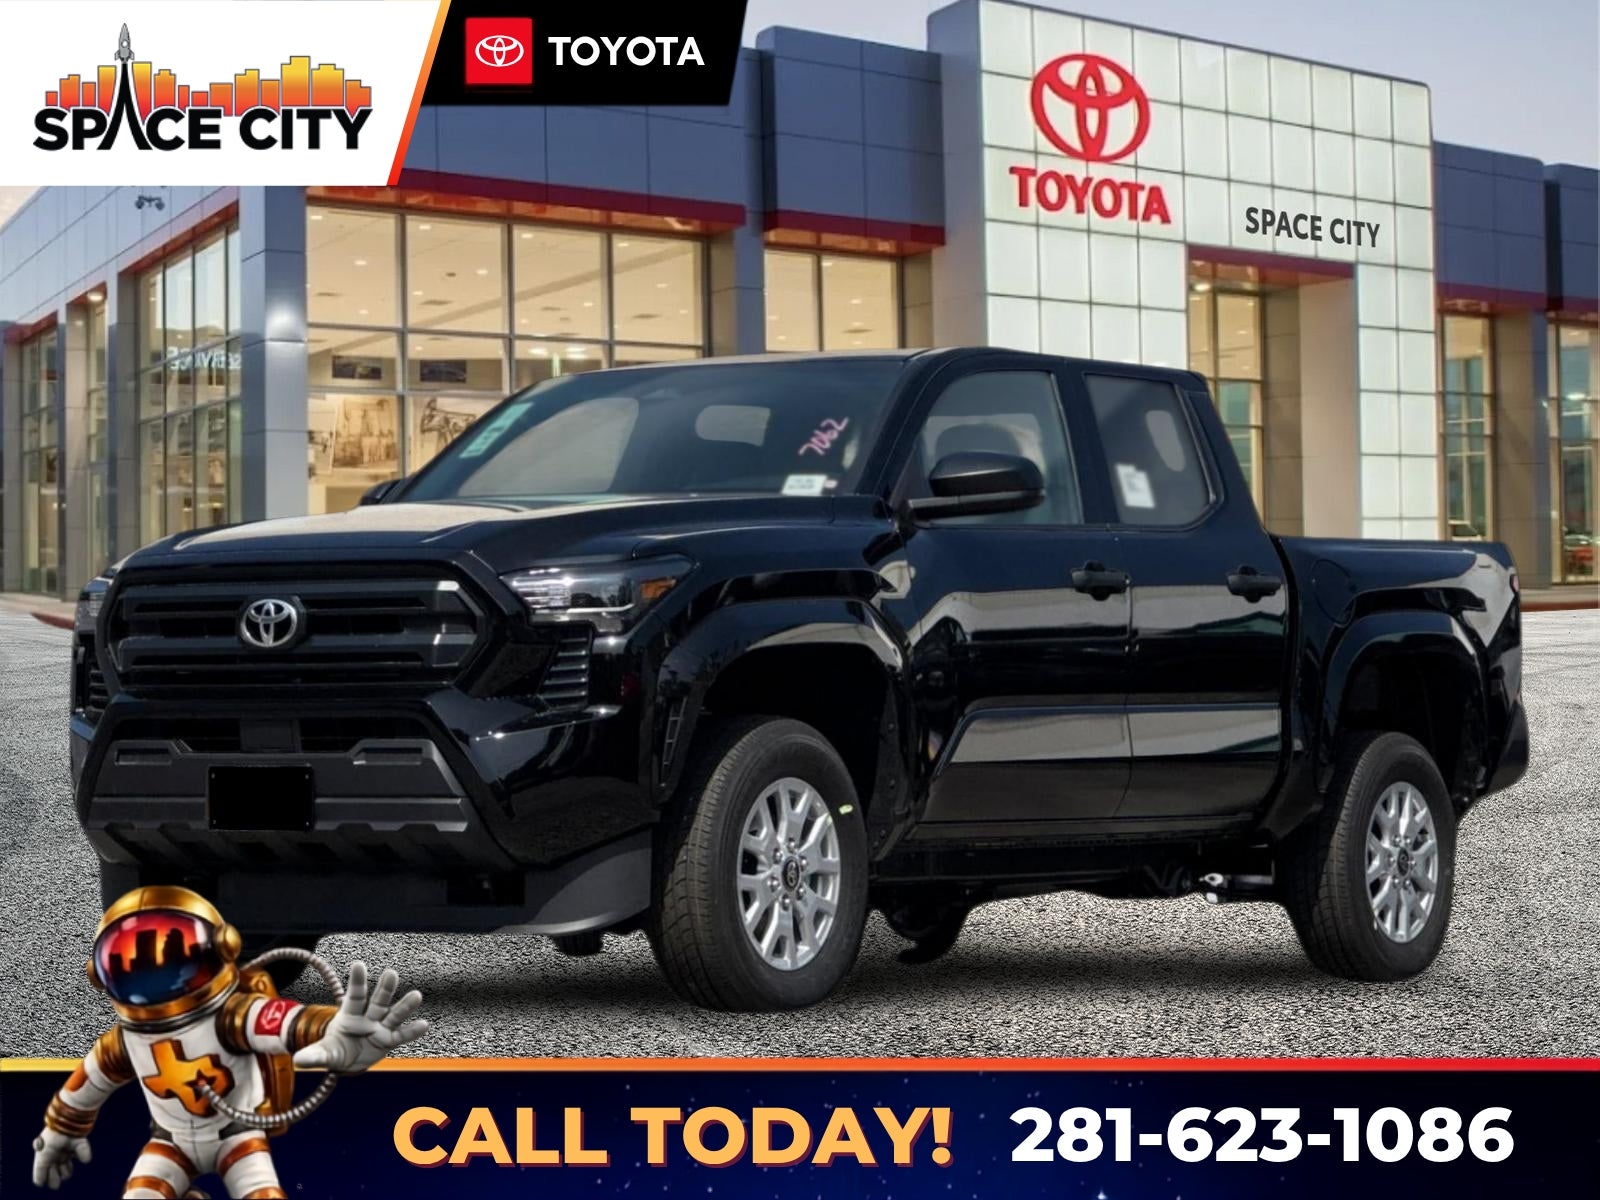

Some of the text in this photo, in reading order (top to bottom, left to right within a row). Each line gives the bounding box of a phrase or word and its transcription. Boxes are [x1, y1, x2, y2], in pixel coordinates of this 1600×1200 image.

[1009, 166, 1171, 224] TOYOTA
[1246, 206, 1380, 248] SPACE CITY
